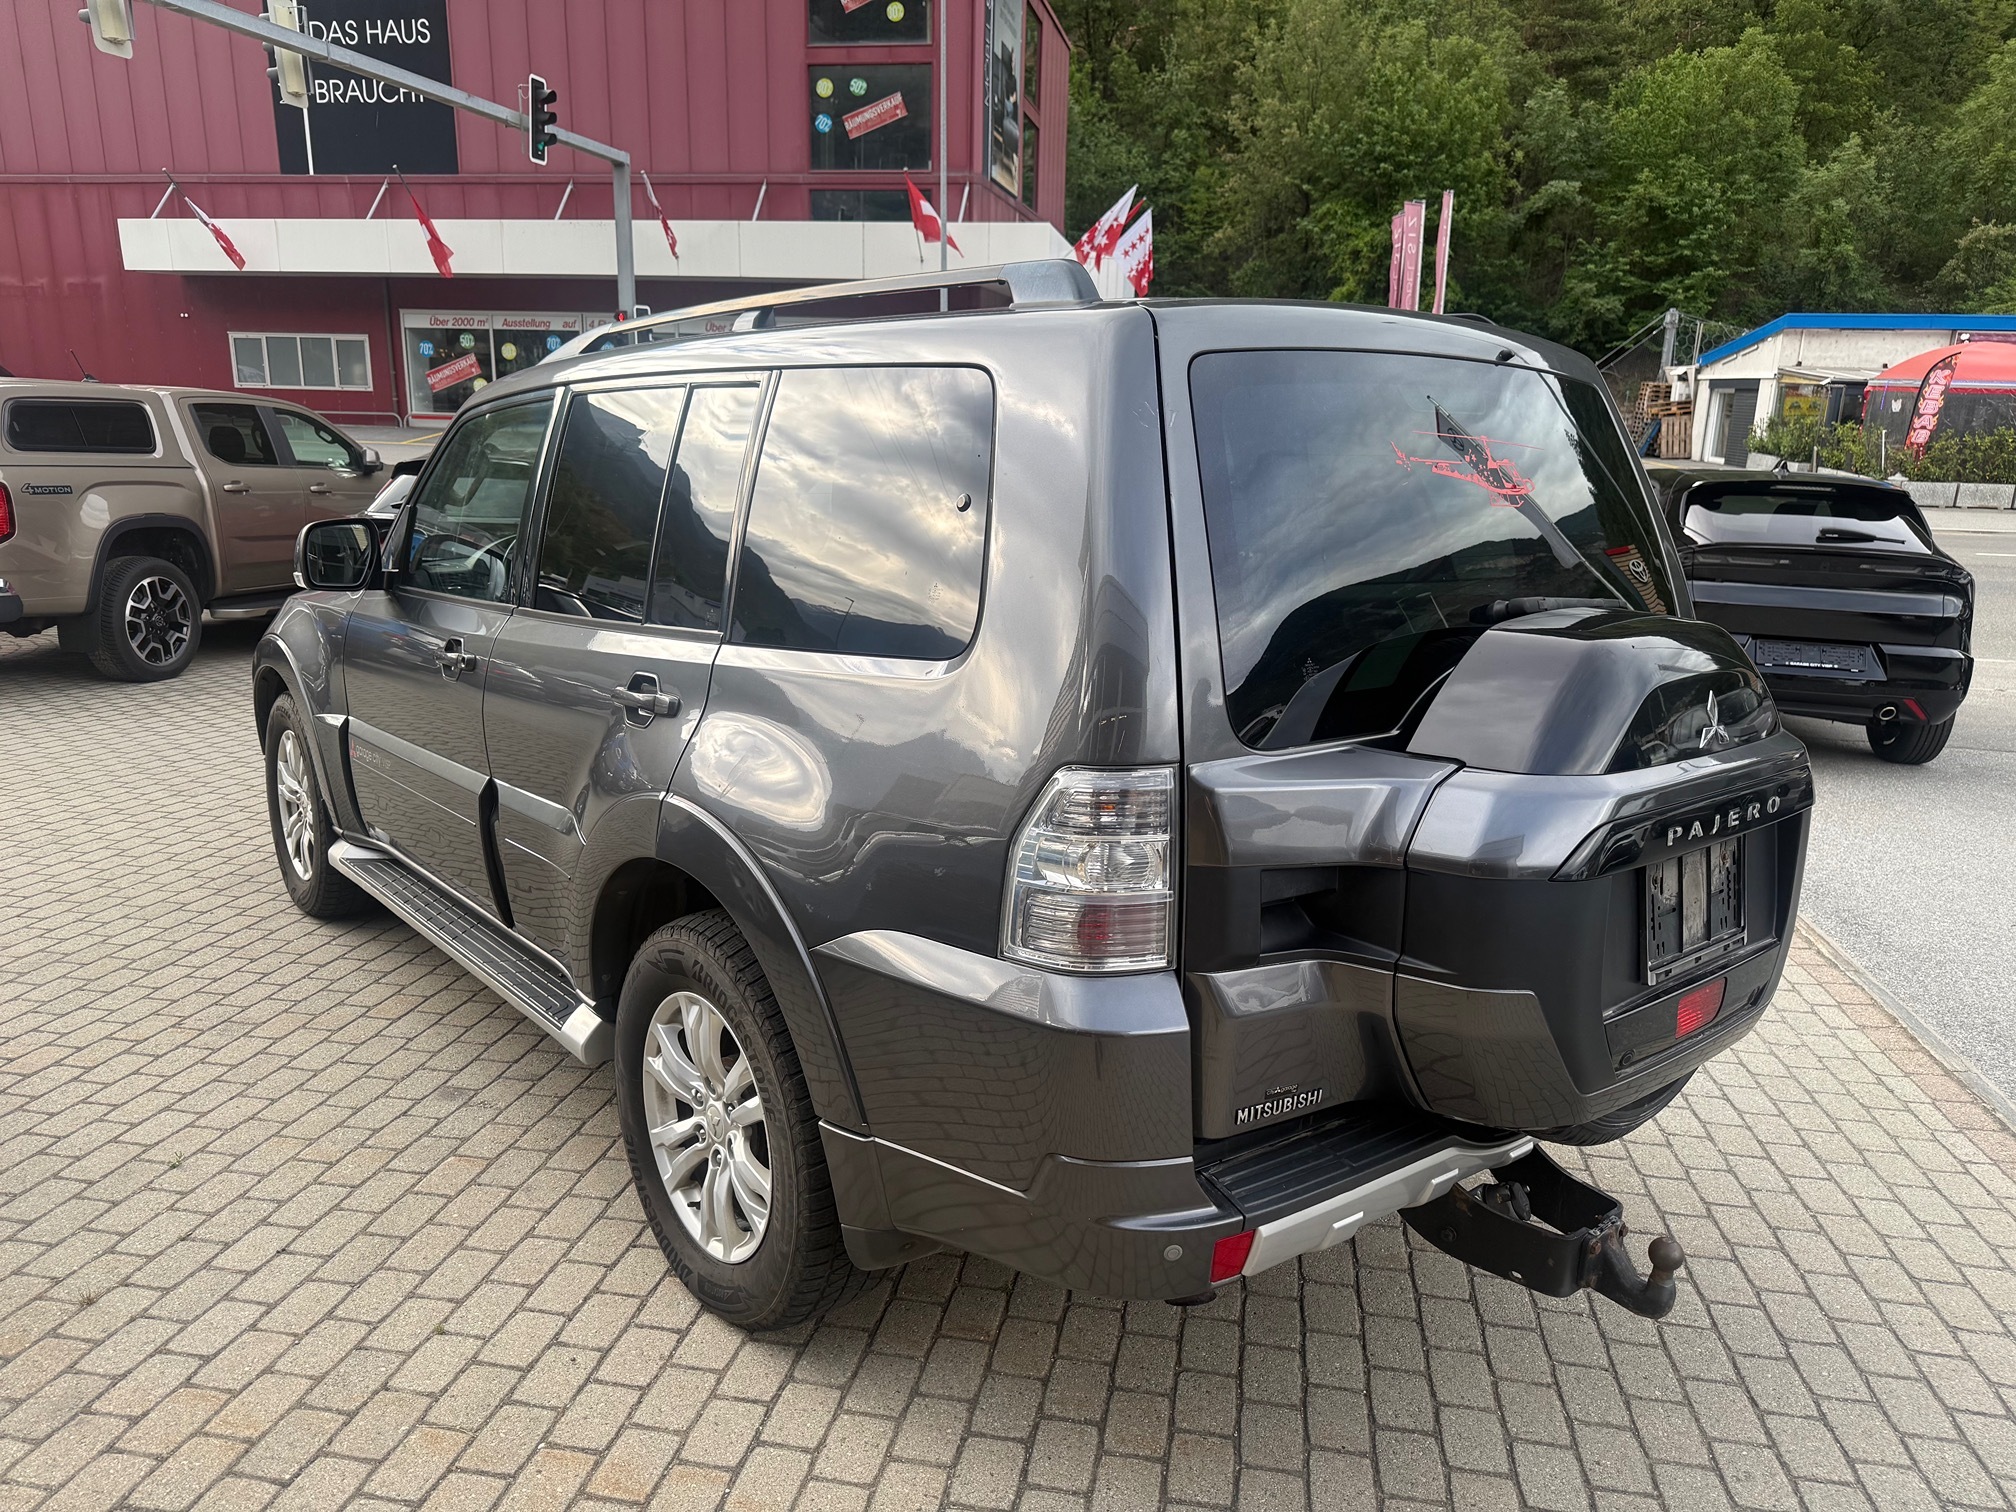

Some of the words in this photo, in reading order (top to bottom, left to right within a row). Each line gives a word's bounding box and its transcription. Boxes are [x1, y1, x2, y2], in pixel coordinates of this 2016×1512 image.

[309, 20, 359, 45] DAS
[366, 18, 431, 44] HAUS
[429, 315, 449, 327] Über
[452, 317, 475, 327] 2000
[502, 318, 551, 330] Ausstellung
[562, 320, 577, 329] auf
[419, 342, 434, 355] 70%
[1910, 369, 1951, 444] KEBAB
[21, 483, 72, 495] 4MOTION
[1667, 796, 1780, 847] PAJERO
[1236, 1089, 1323, 1125] MITSUBISHI
